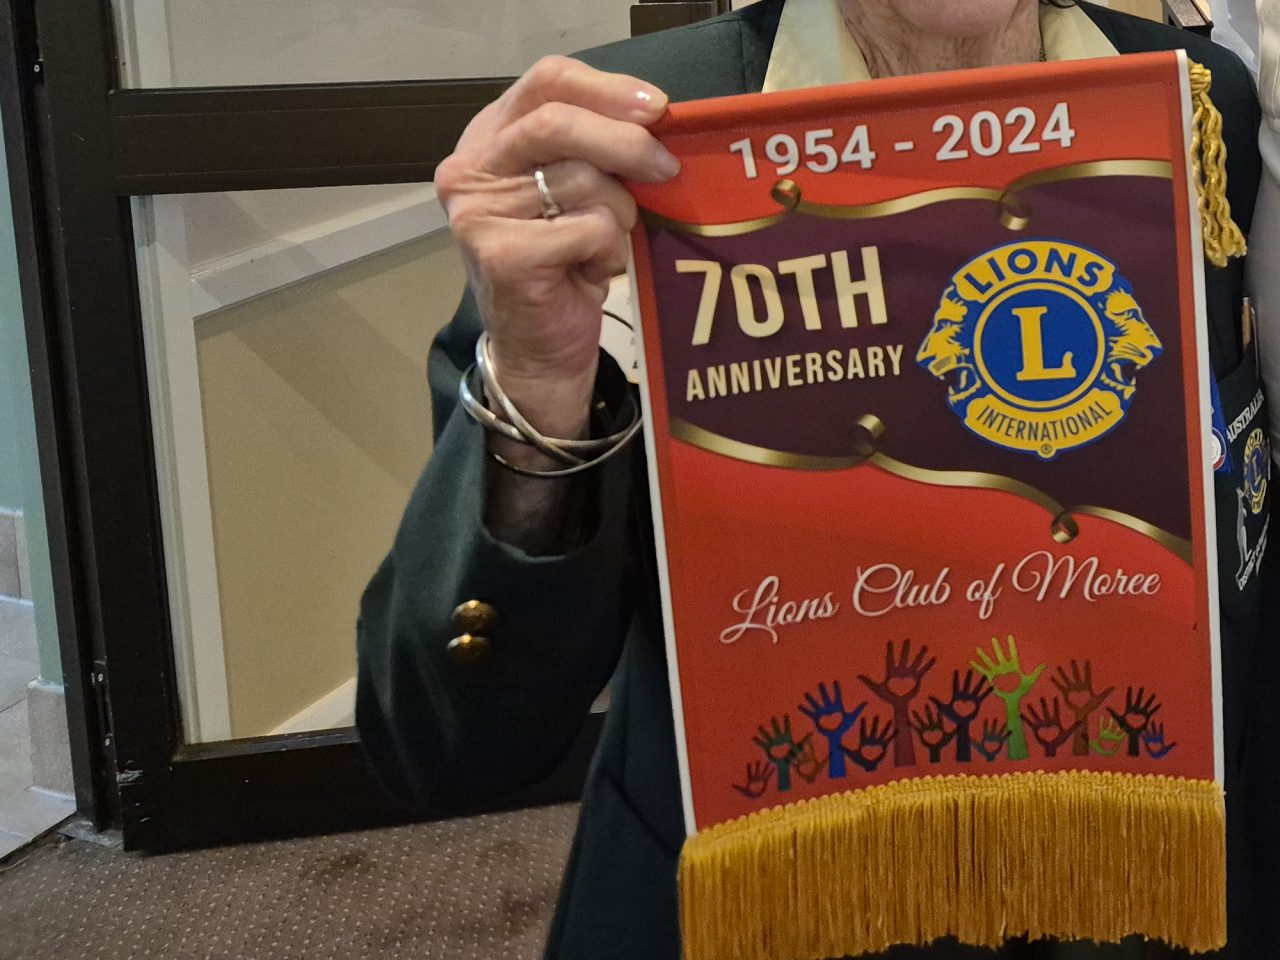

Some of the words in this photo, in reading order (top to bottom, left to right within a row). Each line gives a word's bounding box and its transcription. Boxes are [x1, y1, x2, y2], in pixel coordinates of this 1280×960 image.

[730, 125, 876, 180] 1954
[932, 102, 1076, 163] 2024
[675, 246, 888, 346] 70TH
[963, 247, 1105, 295] LIONS
[686, 344, 904, 402] ANNIVERSARY
[1011, 306, 1077, 381] L
[976, 400, 1113, 441] INTERNATIONAL
[719, 575, 840, 645] Lions
[853, 562, 951, 617] Club
[966, 562, 1006, 621] of
[1011, 550, 1161, 603] Moree
